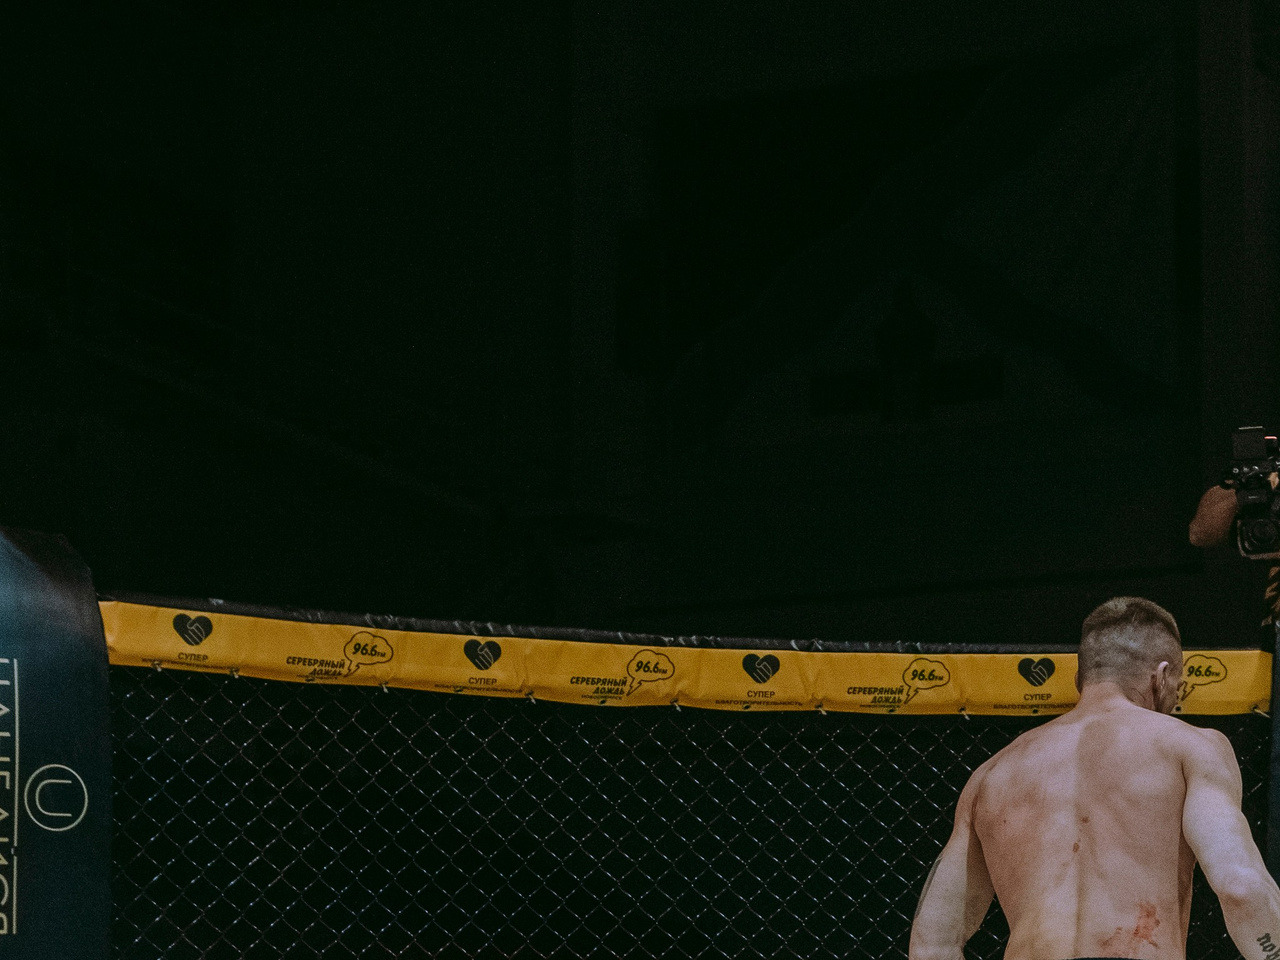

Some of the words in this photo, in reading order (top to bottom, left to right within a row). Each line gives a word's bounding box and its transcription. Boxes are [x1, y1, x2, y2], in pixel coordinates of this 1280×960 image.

[178, 652, 208, 662] СУПЕР
[286, 655, 345, 669] СЕРЕБРЯНЫЙ
[468, 677, 497, 686] СУПЕР
[570, 676, 627, 687] СЕРЕБРЯНЫЙ
[593, 687, 624, 695] ДОЖДЬ
[747, 690, 775, 698] СУПЕР
[847, 685, 904, 695] СЕРЕБРЯНЫЙ
[871, 696, 902, 704] ДОЖДЬ
[1024, 693, 1052, 701] СУПЕР
